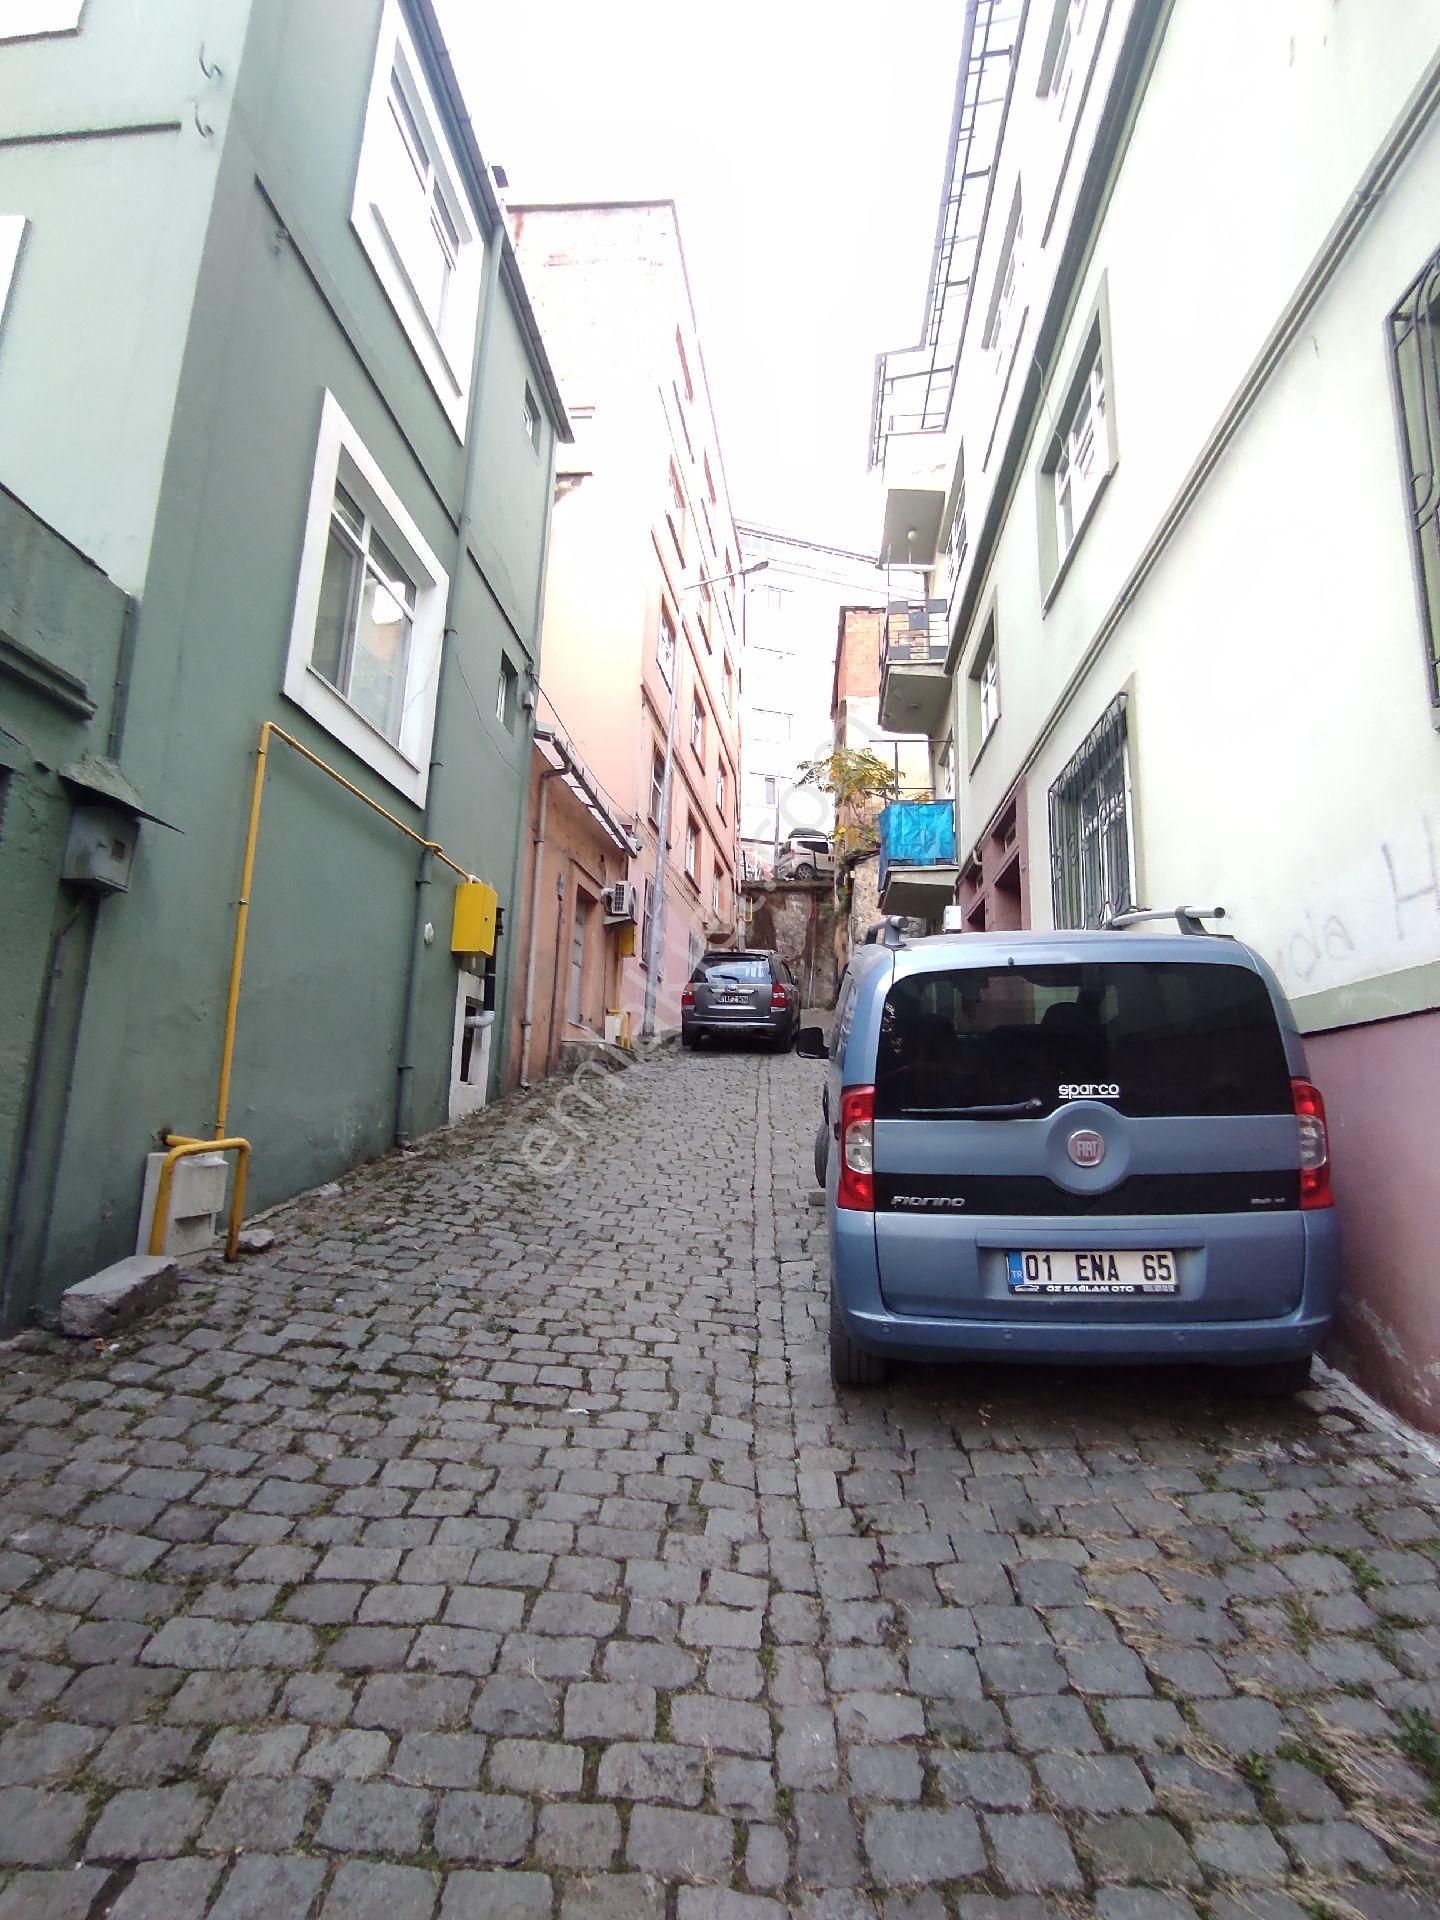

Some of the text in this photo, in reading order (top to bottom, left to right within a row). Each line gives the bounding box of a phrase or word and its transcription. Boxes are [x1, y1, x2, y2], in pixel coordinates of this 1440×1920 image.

[1058, 1083, 1120, 1100] sparco
[1076, 1140, 1099, 1157] FIAT
[1011, 1254, 1172, 1281] TR 01 ENA 65
[1111, 1285, 1135, 1293] OTO
